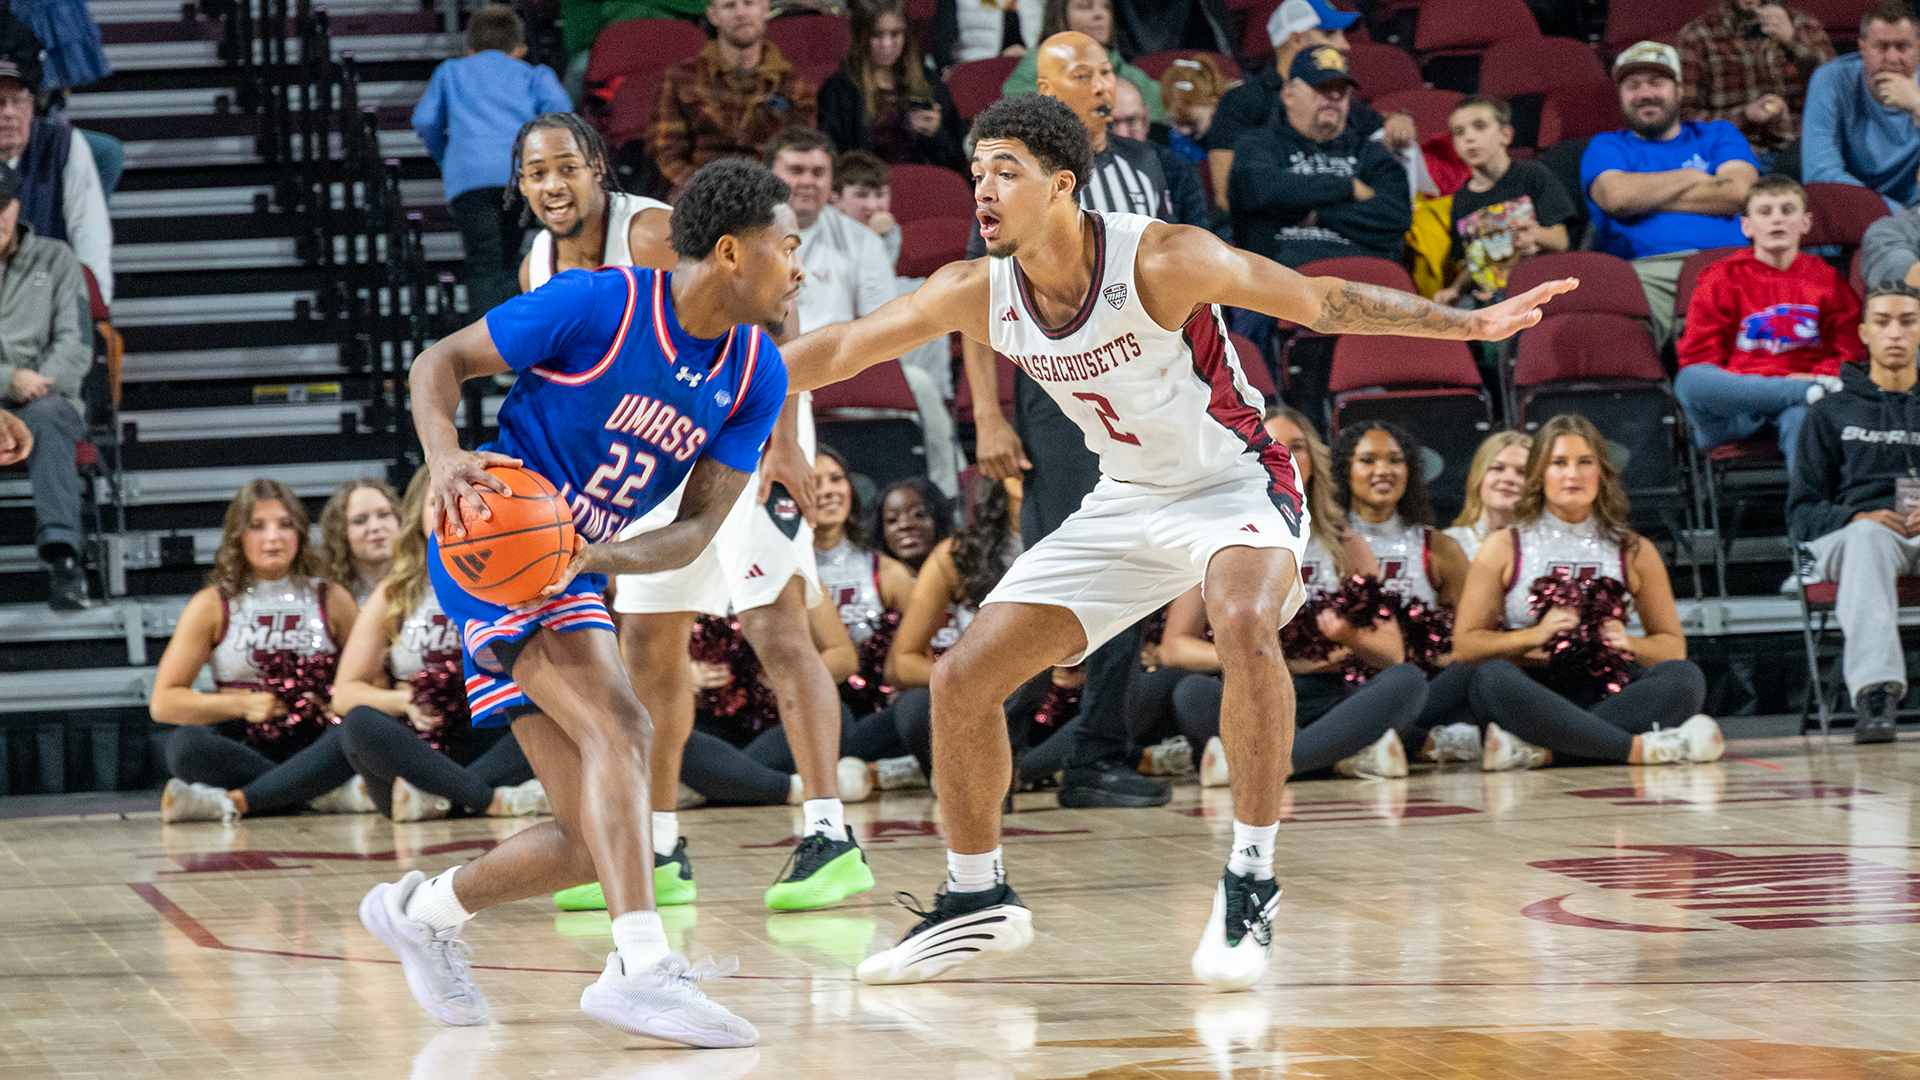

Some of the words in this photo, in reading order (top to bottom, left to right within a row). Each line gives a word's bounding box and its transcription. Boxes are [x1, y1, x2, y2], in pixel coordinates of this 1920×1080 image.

[604, 394, 707, 462] UMASS
[1072, 392, 1142, 447] 2
[584, 442, 657, 508] 22
